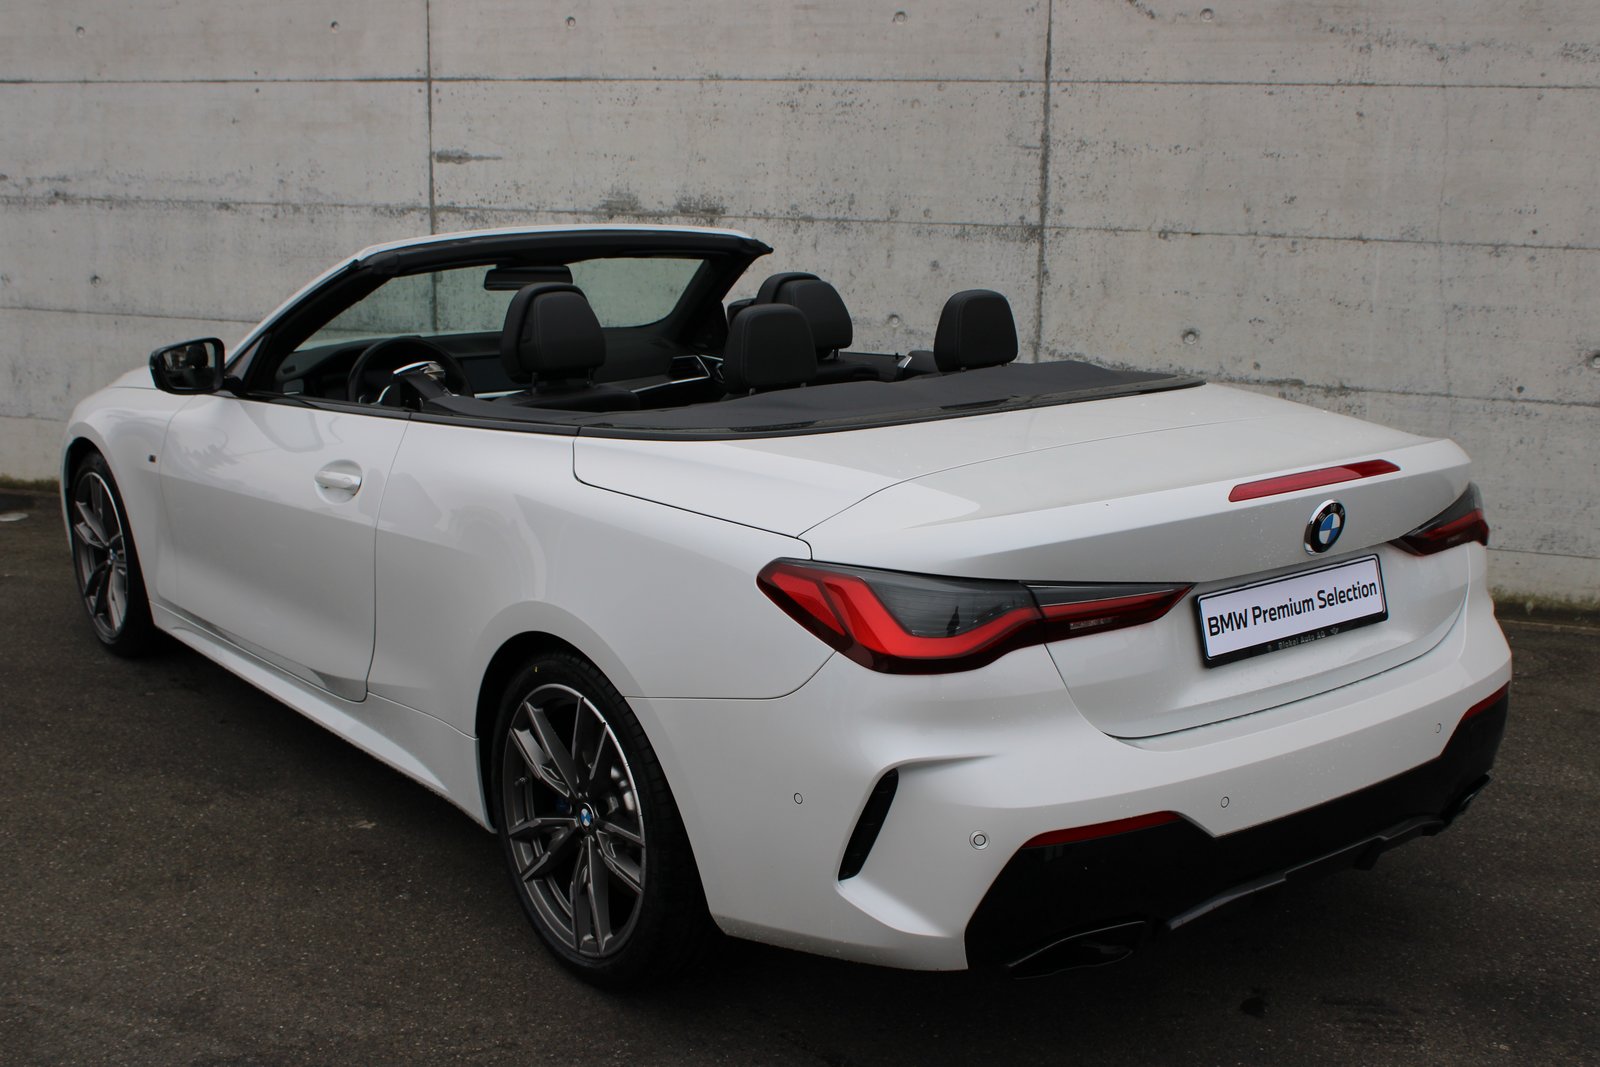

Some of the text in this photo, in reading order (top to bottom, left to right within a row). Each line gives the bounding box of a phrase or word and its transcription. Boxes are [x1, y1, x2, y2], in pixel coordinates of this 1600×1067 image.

[1207, 581, 1377, 637] BMW Premium Selection
[1300, 634, 1315, 644] Auto
